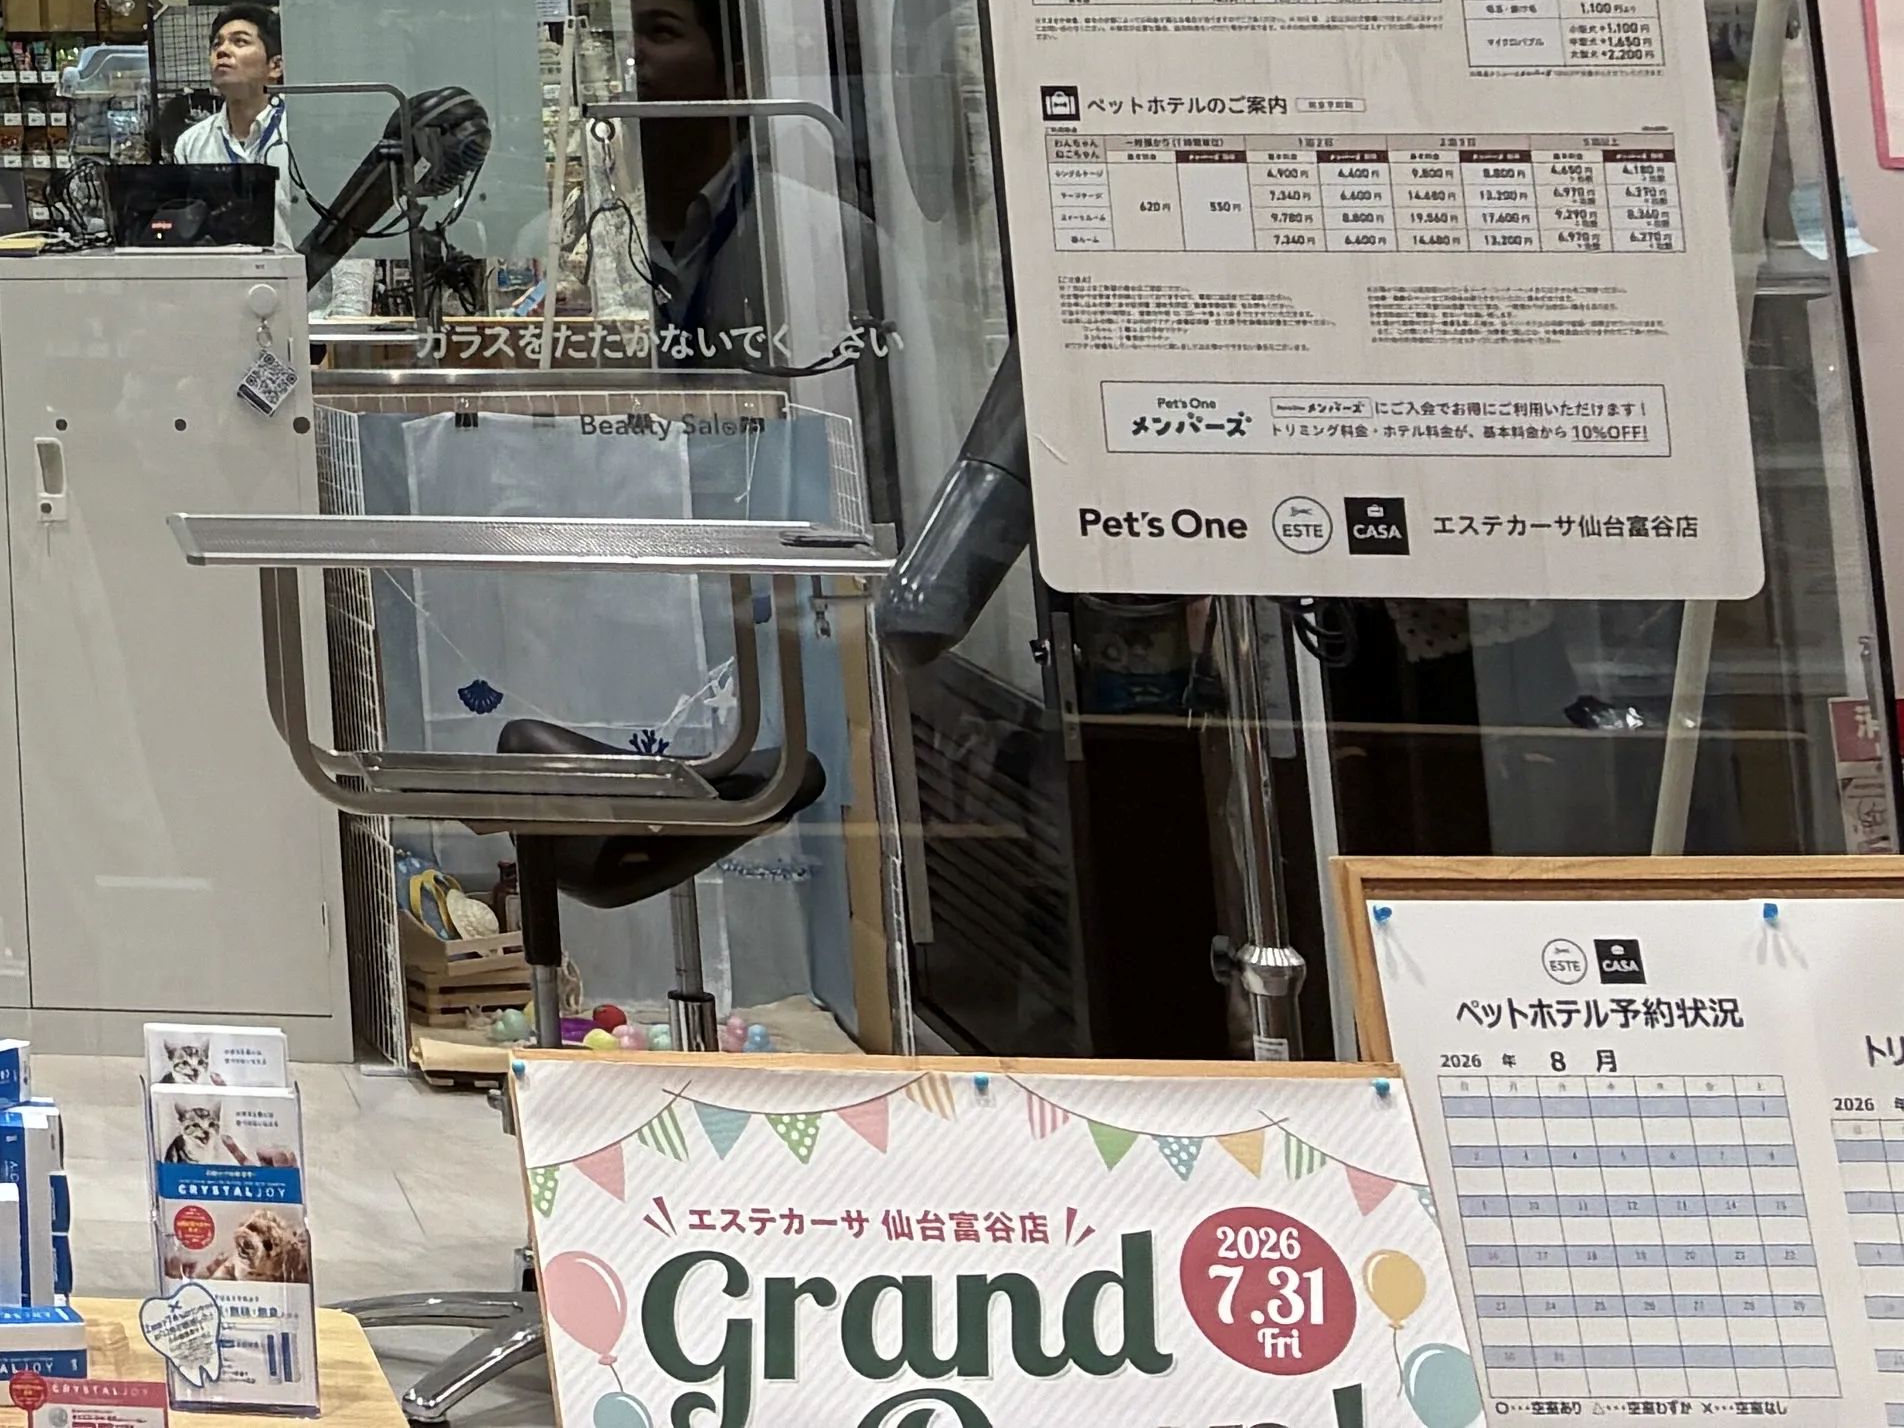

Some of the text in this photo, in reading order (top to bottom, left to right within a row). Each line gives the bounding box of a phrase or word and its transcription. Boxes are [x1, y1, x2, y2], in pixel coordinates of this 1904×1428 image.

[1087, 95, 1287, 115] ペットホテルのご案内
[418, 324, 904, 360] ガラスをたたかないでくさい
[1157, 397, 1216, 409] Pet's One
[580, 413, 672, 440] Beauty
[1132, 412, 1252, 437] メンバーズ
[1572, 425, 1648, 440] 10%OFF!
[1079, 506, 1248, 540] Pet's One
[1282, 524, 1402, 539] ESTE CASA
[1433, 515, 1700, 540] エステカーサ仙台富谷店
[1550, 960, 1640, 972] ESTE CASA
[1457, 998, 1743, 1028] ペットホテル予約状況
[1441, 1050, 1617, 1072] 2026 年 8 月
[1833, 1098, 1874, 1111] 2026
[178, 1185, 286, 1197] CRYSTALJOY
[688, 1207, 1050, 1244] エステカーサ 仙台富谷店
[1216, 1227, 1301, 1259] 2026
[1209, 1265, 1324, 1325] 7.31
[641, 1230, 1174, 1428] Grand
[1257, 1328, 1302, 1358] Fri
